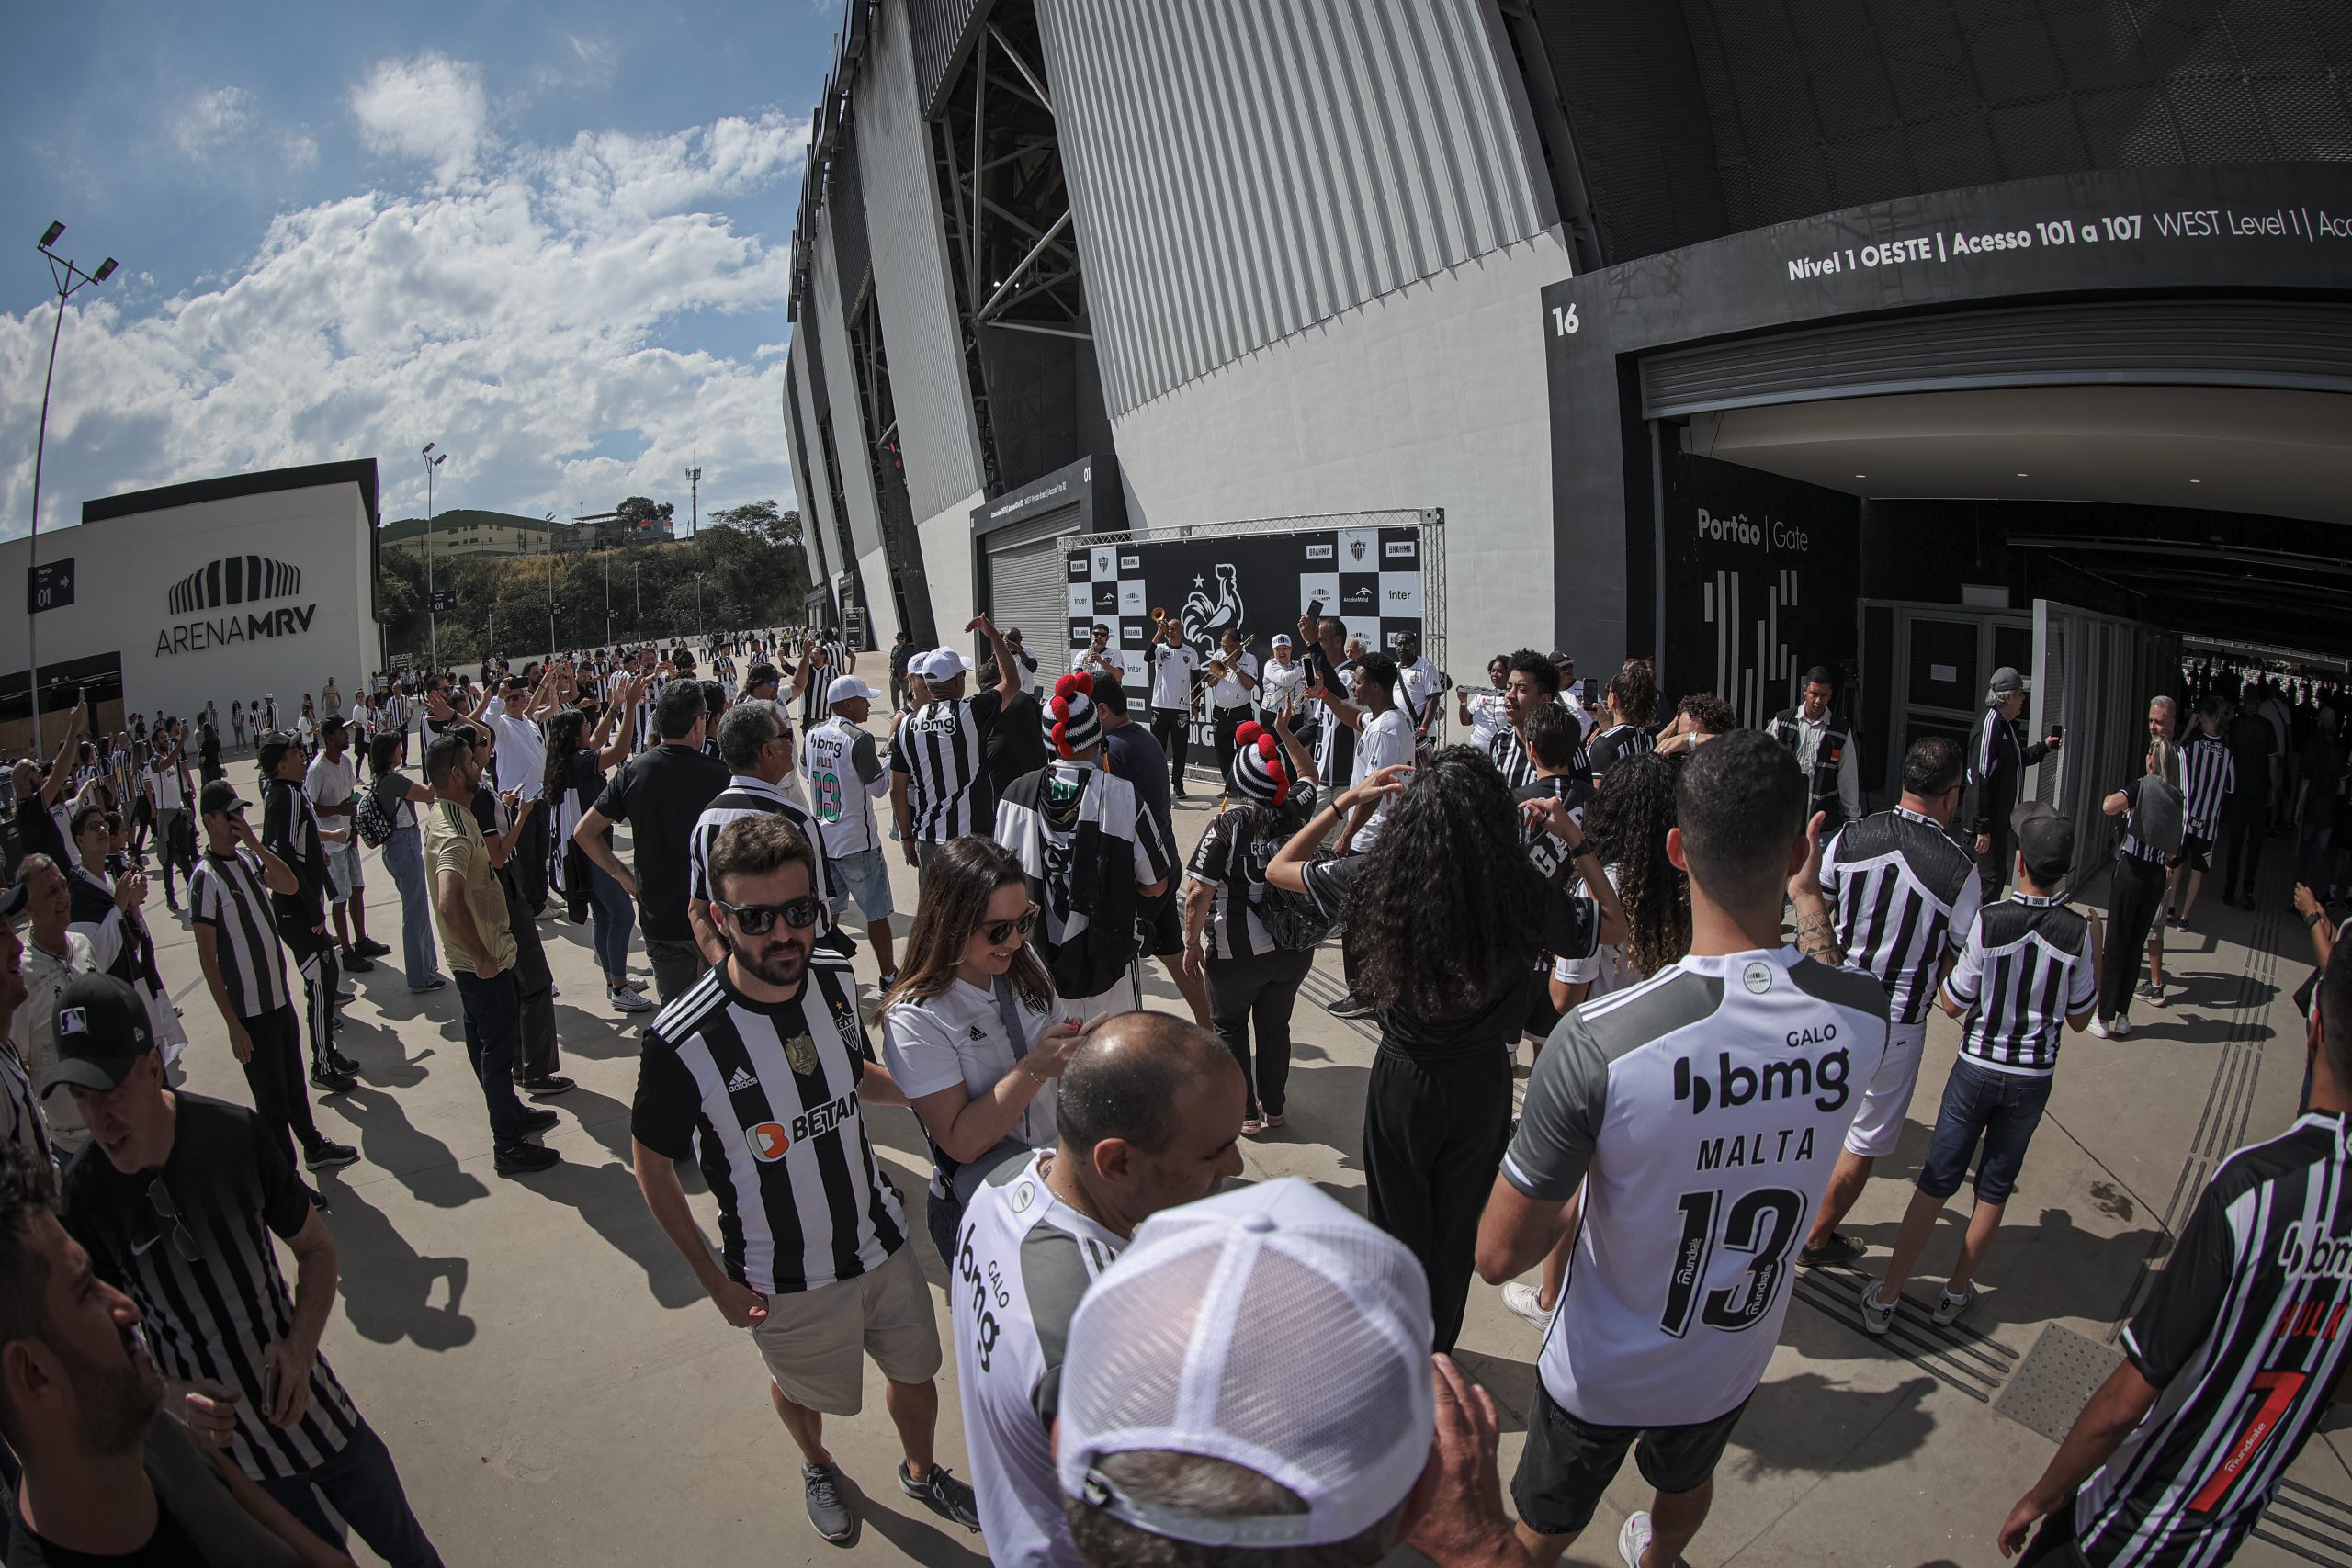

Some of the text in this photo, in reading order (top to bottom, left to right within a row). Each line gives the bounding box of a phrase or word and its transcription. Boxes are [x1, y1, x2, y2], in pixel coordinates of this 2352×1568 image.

[1788, 251, 1841, 281] Nível
[1846, 249, 1855, 270] 1
[1860, 237, 1932, 267] OESTE
[1952, 231, 2032, 255] Acesso
[2036, 220, 2075, 246] 101
[2081, 224, 2098, 243] a
[2101, 215, 2142, 241] 107
[2153, 210, 2221, 237] WEST
[2227, 209, 2287, 235] Level
[2289, 209, 2301, 235] 1
[1551, 302, 1580, 337] 16
[1083, 467, 1091, 483] 01
[1697, 508, 1808, 552] Portão Gate
[1308, 547, 1330, 557] BRAHMA
[1388, 545, 1412, 554] BRAHMA
[38, 587, 51, 607] 01
[435, 602, 444, 611] 01
[1073, 596, 1088, 604] inter
[1388, 590, 1411, 600] inter
[1126, 664, 1142, 673] inter
[921, 716, 957, 736] bmg
[817, 735, 842, 759] bmg
[2206, 741, 2223, 758] bmg
[812, 770, 842, 824] 13
[1296, 785, 1315, 807] MRV
[1195, 826, 1217, 871] MRV
[1786, 1024, 1837, 1048] GALO
[728, 1077, 759, 1093] adidas
[1719, 1046, 1849, 1113] bmg
[1695, 1126, 1815, 1172] MALTA
[1659, 1187, 1809, 1338] 13
[1676, 1237, 1702, 1286] mundiale
[959, 1221, 1001, 1374] bmg
[988, 1259, 1010, 1310] GALO
[1745, 1263, 1774, 1316] mundiale
[2275, 1300, 2350, 1341] HULK
[2224, 1422, 2267, 1473] mundiale
